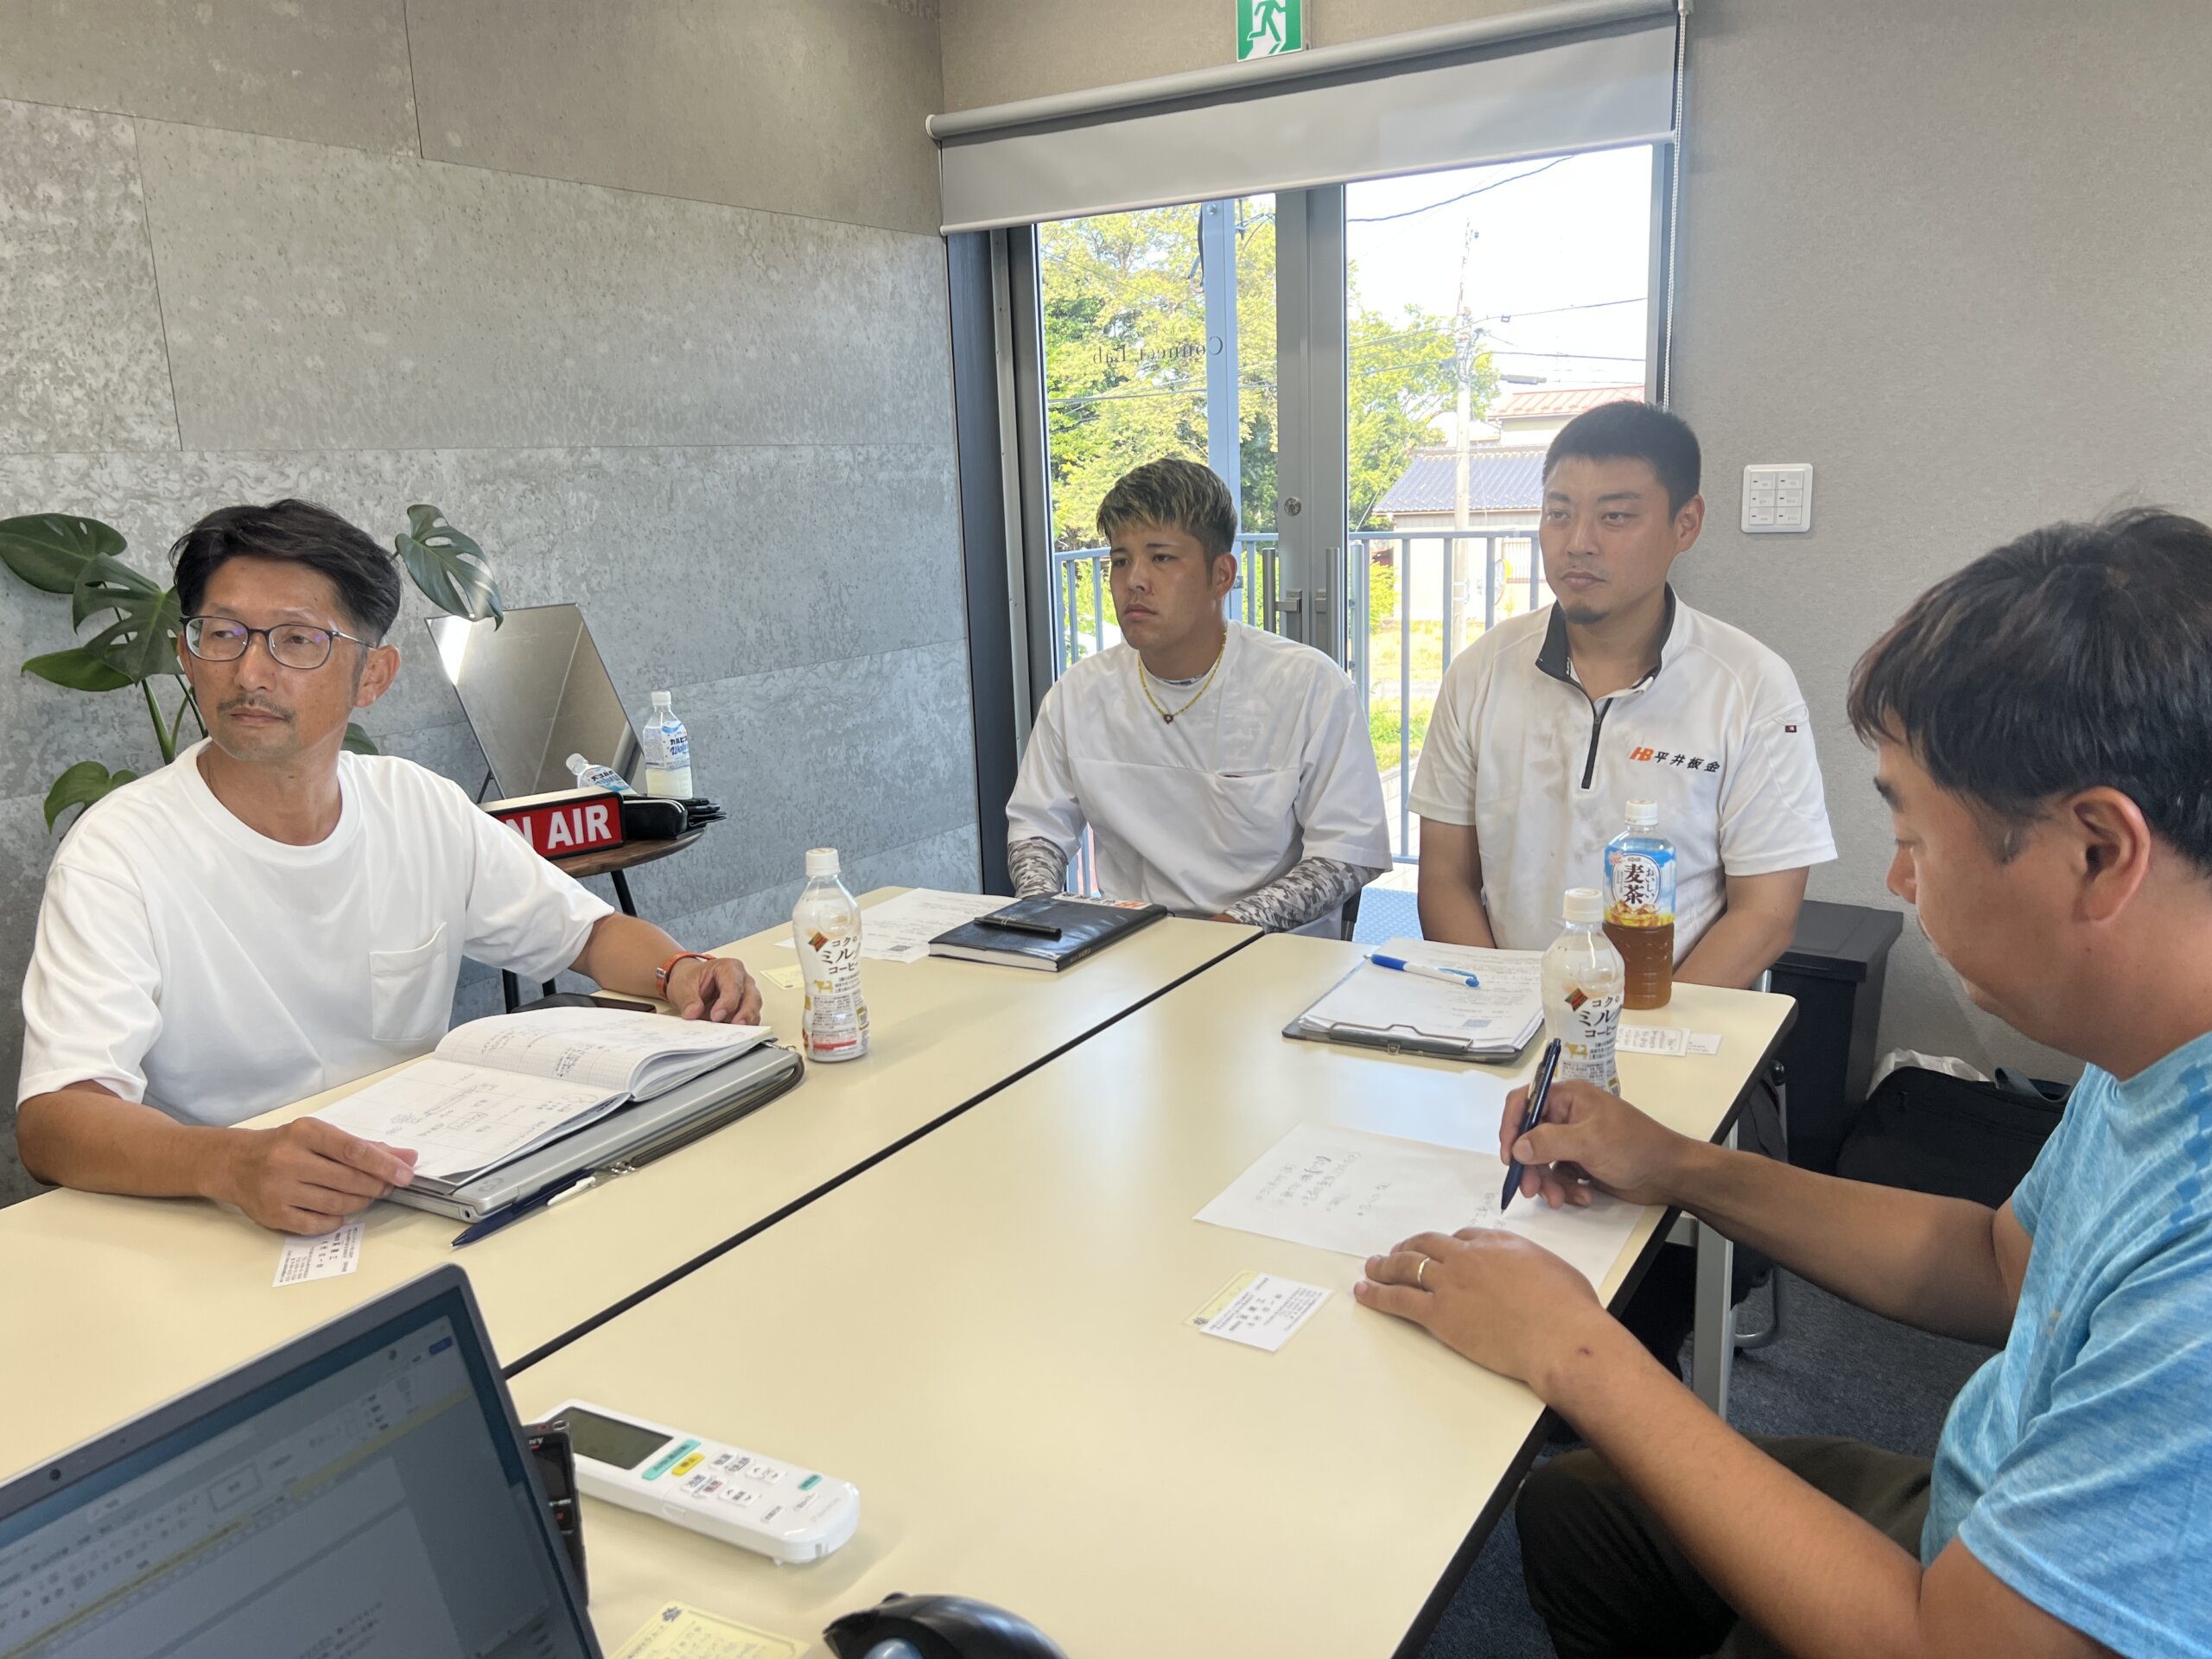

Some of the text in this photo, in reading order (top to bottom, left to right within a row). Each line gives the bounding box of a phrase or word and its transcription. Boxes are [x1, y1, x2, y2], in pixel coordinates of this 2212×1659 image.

[1629, 747, 1654, 761] HB
[1654, 751, 1720, 772] 平井板金
[505, 804, 612, 849] N AIR
[1623, 863, 1644, 904] 麦茶
[1645, 868, 1655, 899] おいしい
[832, 936, 857, 947] コクの
[1592, 995, 1620, 1007] コクの
